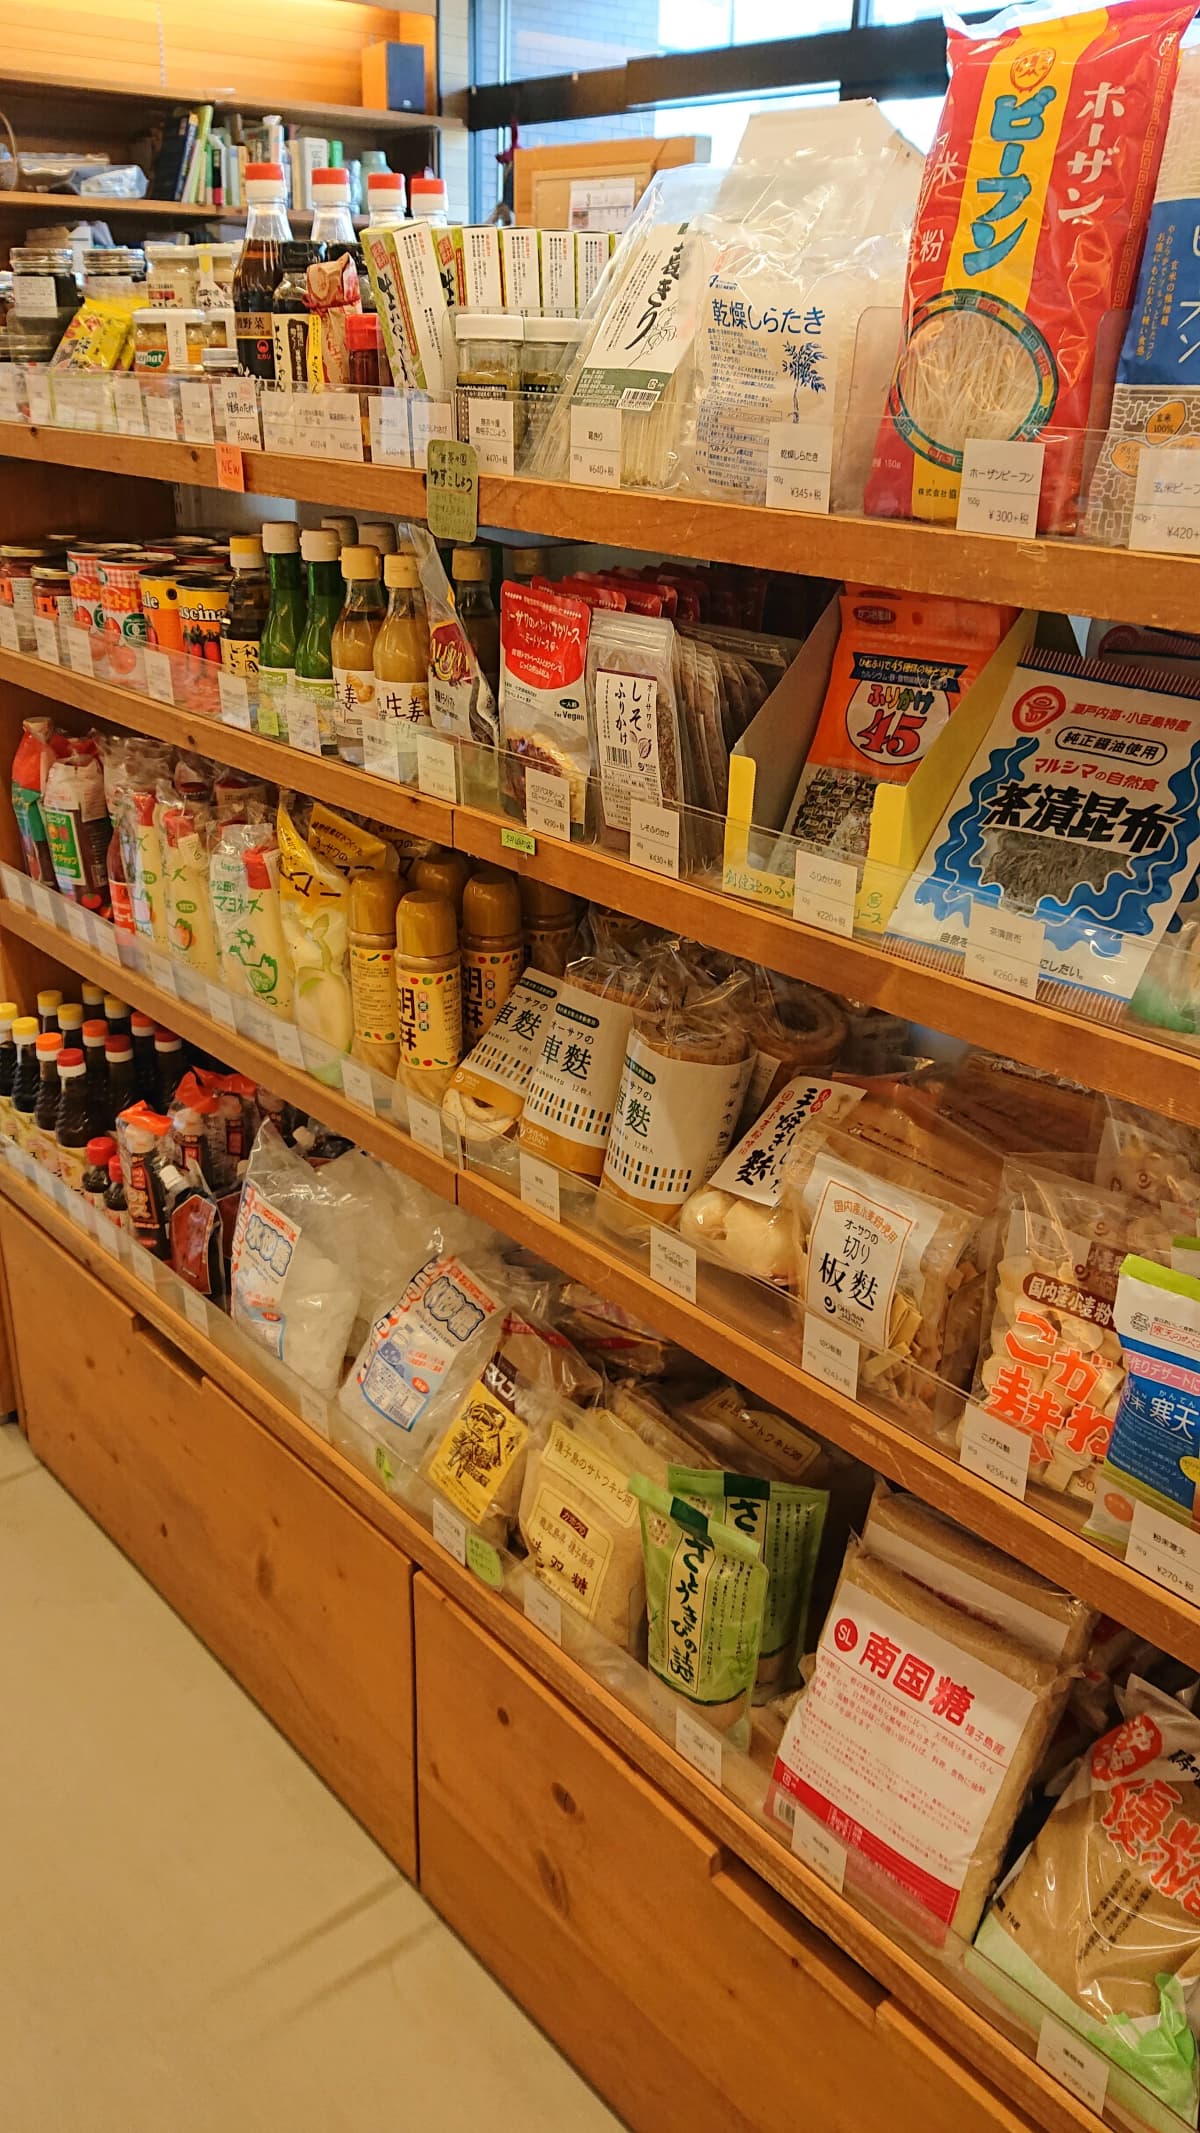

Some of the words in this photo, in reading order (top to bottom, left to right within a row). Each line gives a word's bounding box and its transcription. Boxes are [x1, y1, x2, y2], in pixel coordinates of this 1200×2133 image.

[1058, 82, 1126, 224] ホーザン
[963, 85, 1057, 277] ビーフン
[711, 298, 826, 335] 乾燥しらたき
[1153, 423, 1174, 434] 100%
[220, 460, 240, 475] NEW
[780, 449, 819, 462] 乾燥しらたき
[968, 468, 1035, 483] ホーザンビーフン
[988, 509, 1030, 526] ¥300+税
[386, 691, 425, 723] 生姜
[614, 681, 628, 746] ふりかけ
[629, 679, 642, 732] しそ
[646, 682, 654, 730] オーサワの
[867, 684, 935, 714] ふりかけ
[562, 710, 585, 722] Vegan
[1069, 703, 1192, 733] 瀬戸内海・小豆島特産
[855, 708, 928, 757] 45
[1033, 758, 1161, 793] マルシマの自然食
[639, 823, 671, 839] しそふりかけ
[981, 782, 1190, 854] 茶漬昆布
[213, 891, 264, 914] マヨネーズ
[816, 910, 847, 927] ¥220+税
[992, 969, 1029, 988] ¥260+税
[493, 1001, 543, 1042] 車麩
[551, 1021, 595, 1045] オーサワの
[541, 1034, 592, 1080] 車麩
[833, 1199, 898, 1245] 国内産小麦粉使用
[843, 1219, 879, 1246] オーサワの
[842, 1235, 871, 1265] 切り
[818, 1252, 880, 1312] 板麩
[1027, 1278, 1115, 1327] 国内産小麦粉
[1159, 1389, 1197, 1409] かんてん
[1149, 1396, 1199, 1440] 寒天
[555, 1438, 633, 1507] 種子島のサトウキビ畑
[1076, 1477, 1097, 1494] 30
[1156, 1564, 1195, 1593] ¥270+税
[836, 1623, 854, 1647] SL
[858, 1631, 976, 1727] 南国糖
[964, 1723, 1007, 1757] 種子島産
